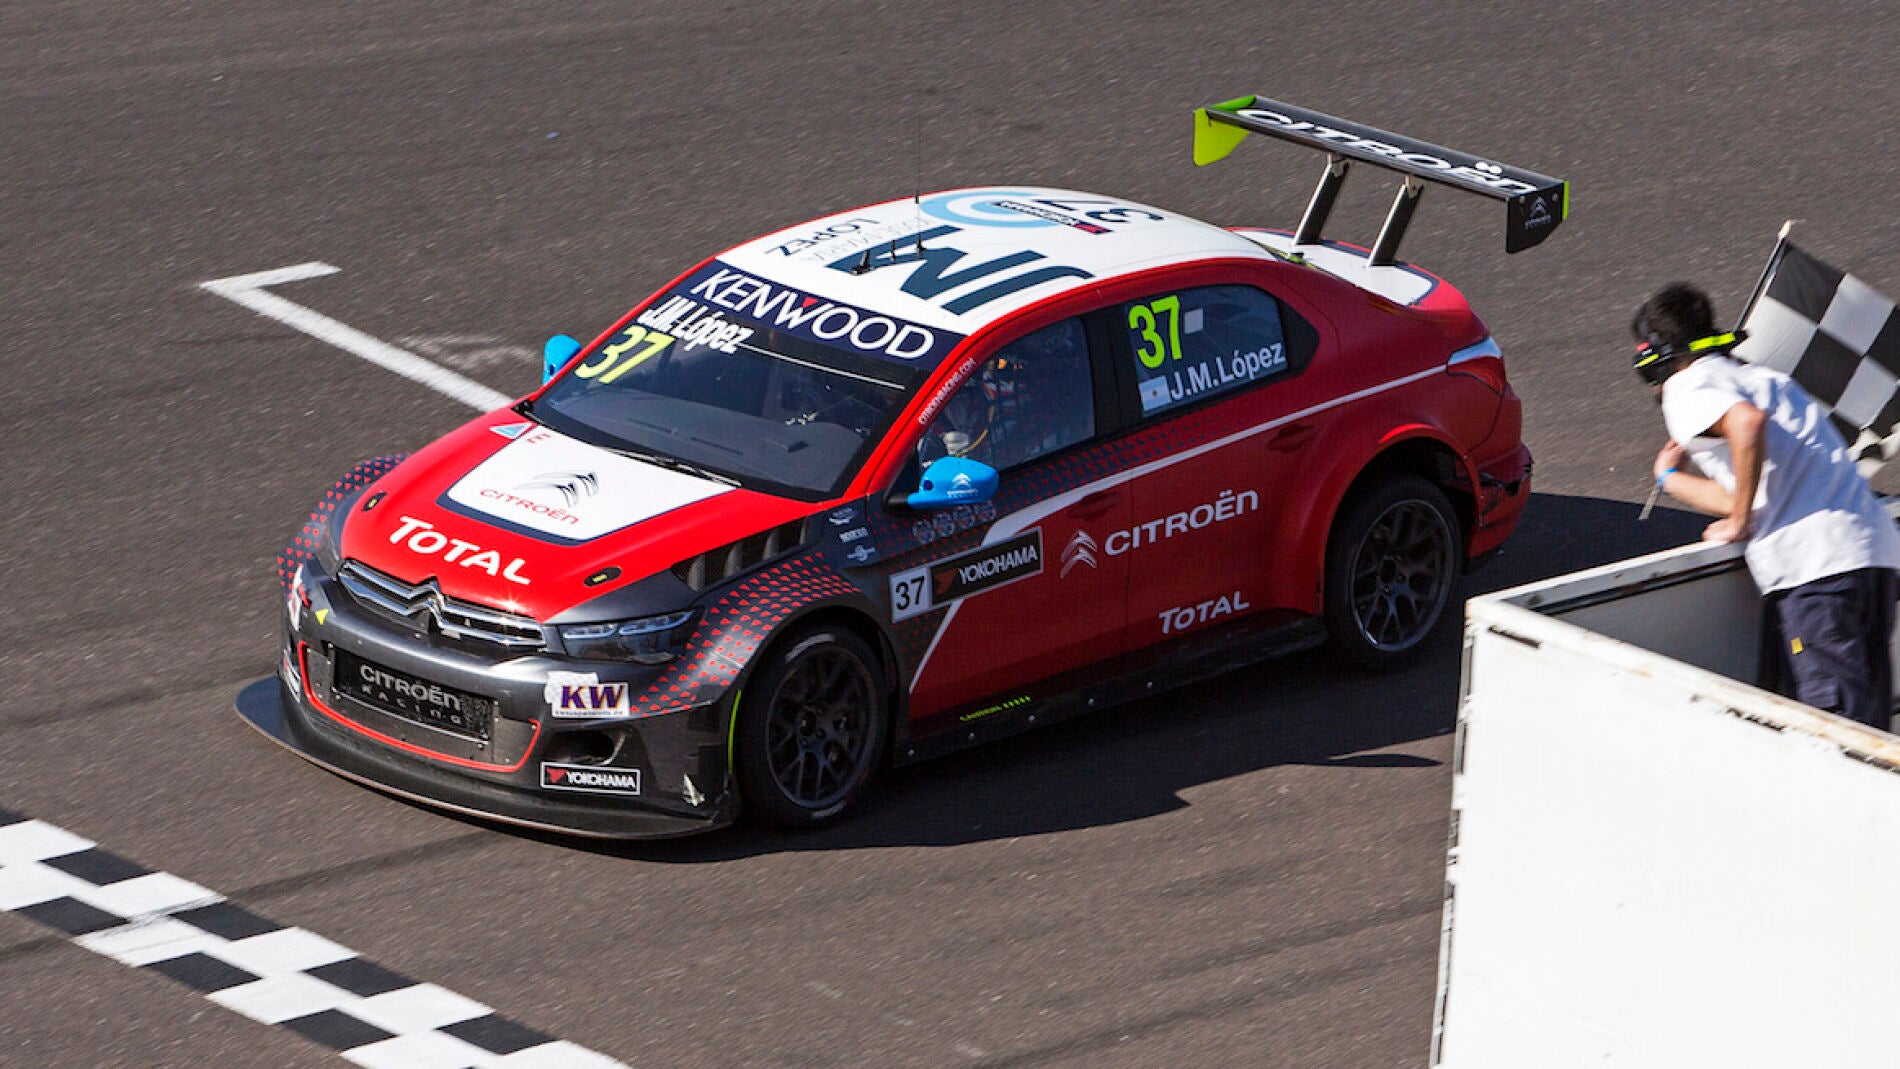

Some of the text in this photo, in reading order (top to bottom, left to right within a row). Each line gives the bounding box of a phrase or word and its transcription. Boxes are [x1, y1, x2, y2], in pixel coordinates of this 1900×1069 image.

[690, 268, 935, 359] KENWOOD
[1129, 295, 1183, 368] 37
[575, 325, 676, 384] 37
[389, 515, 532, 585] TOTAL
[958, 544, 1039, 585] YOKOHAMA
[895, 576, 925, 610] 37
[1158, 591, 1251, 634] TOTAL
[560, 685, 626, 710] KW
[566, 771, 636, 788] YOKOHAMA
